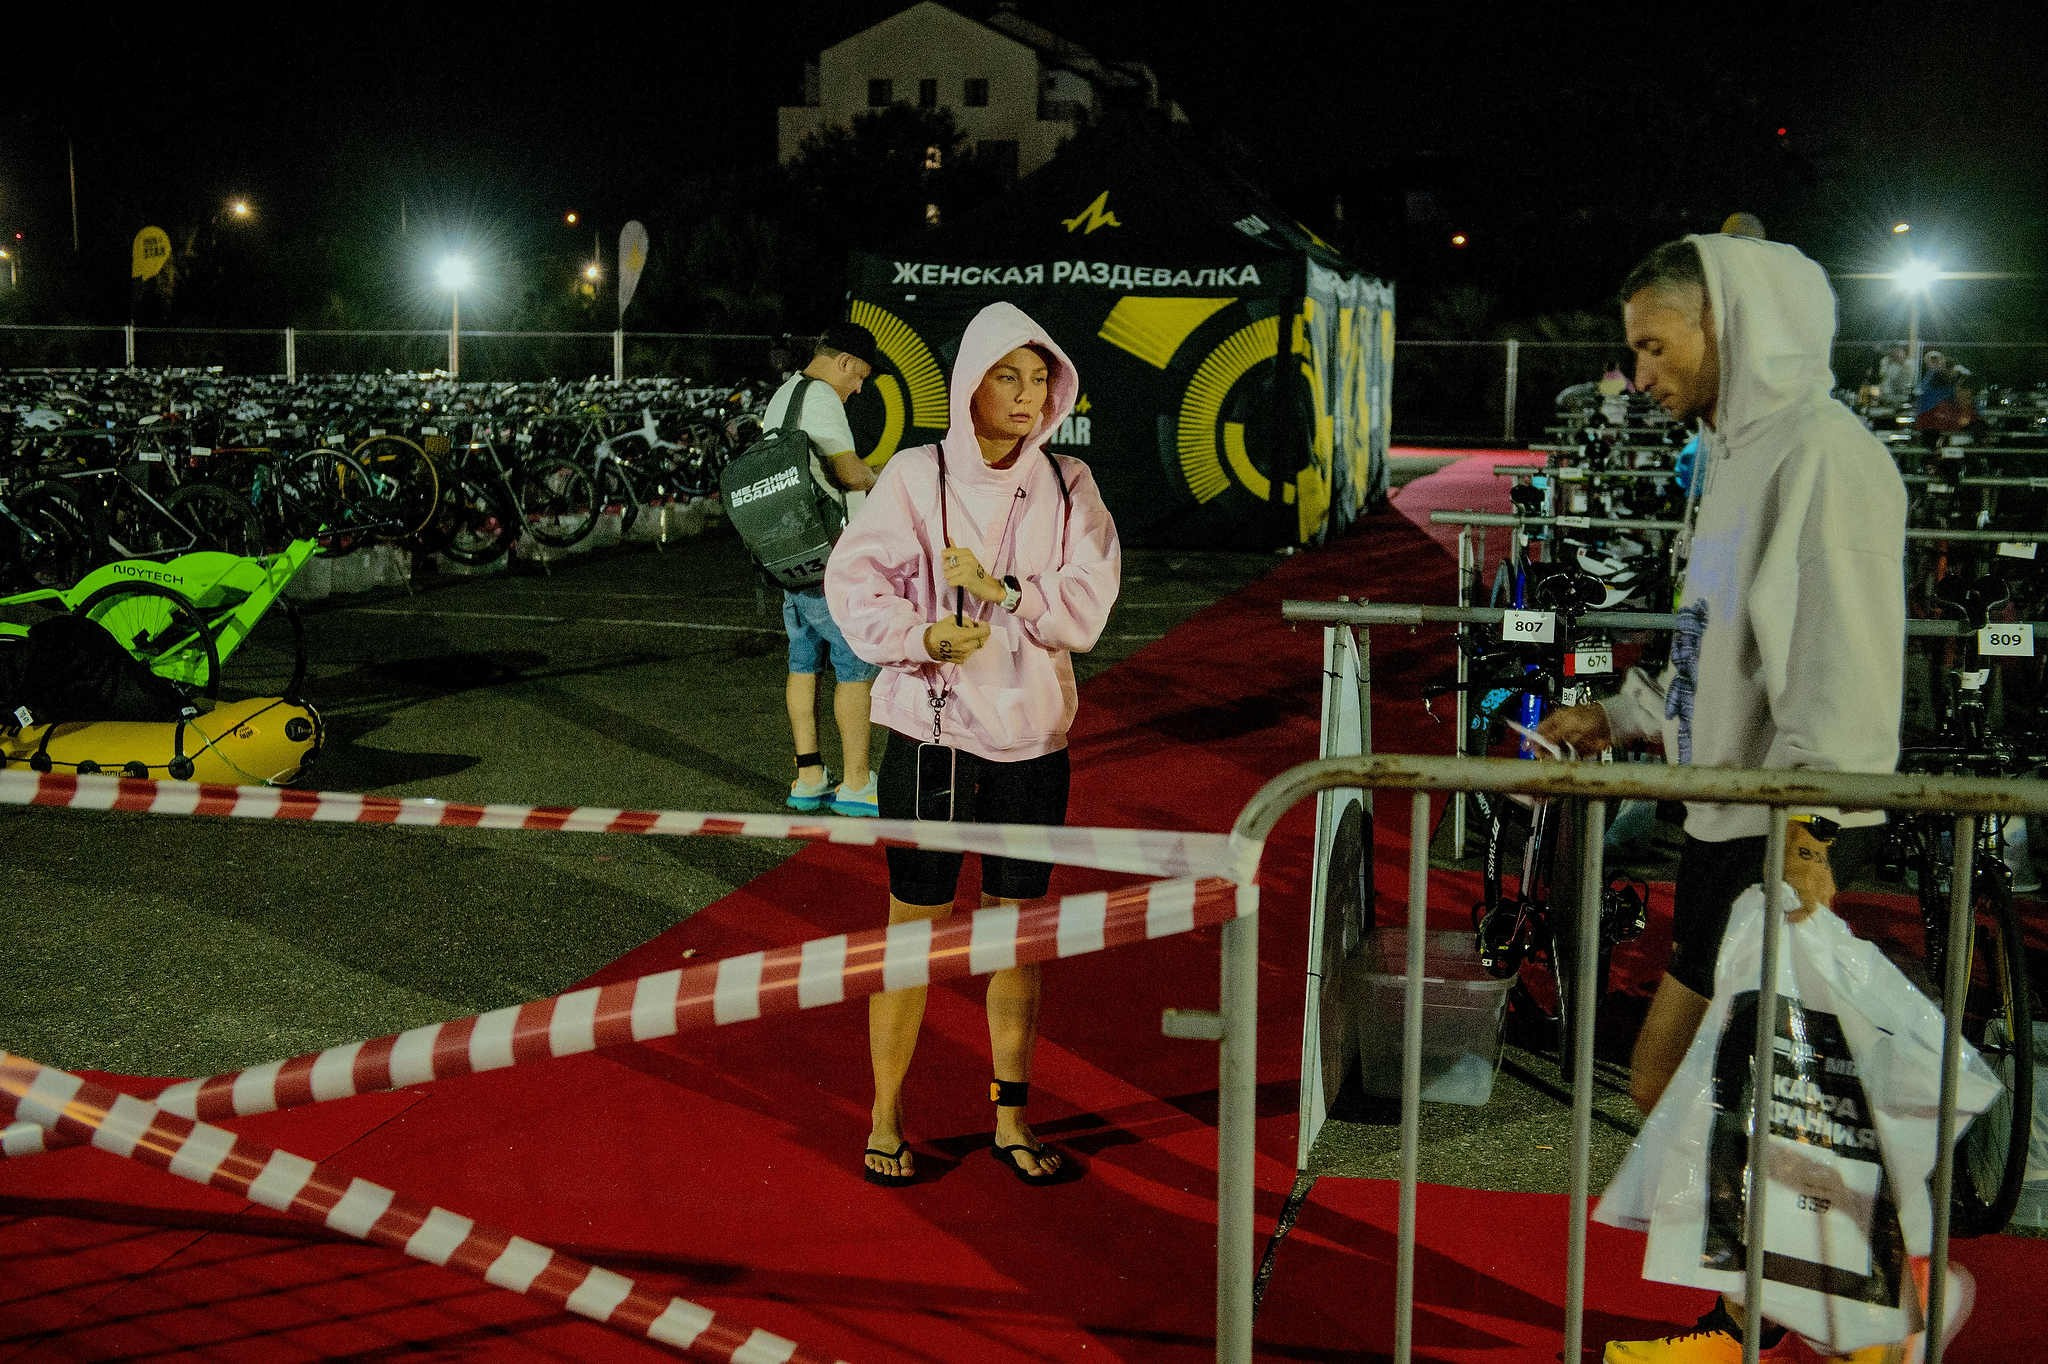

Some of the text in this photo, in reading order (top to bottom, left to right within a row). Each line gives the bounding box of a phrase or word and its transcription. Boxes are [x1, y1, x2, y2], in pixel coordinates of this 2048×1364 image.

[892, 260, 1261, 290] ЖЕНСКАЯ РАЗДЕВАЛКА
[1515, 621, 1543, 633] 807
[1990, 633, 2022, 646] 809
[1587, 655, 1607, 668] 679
[1487, 816, 1501, 881] DT SWISS
